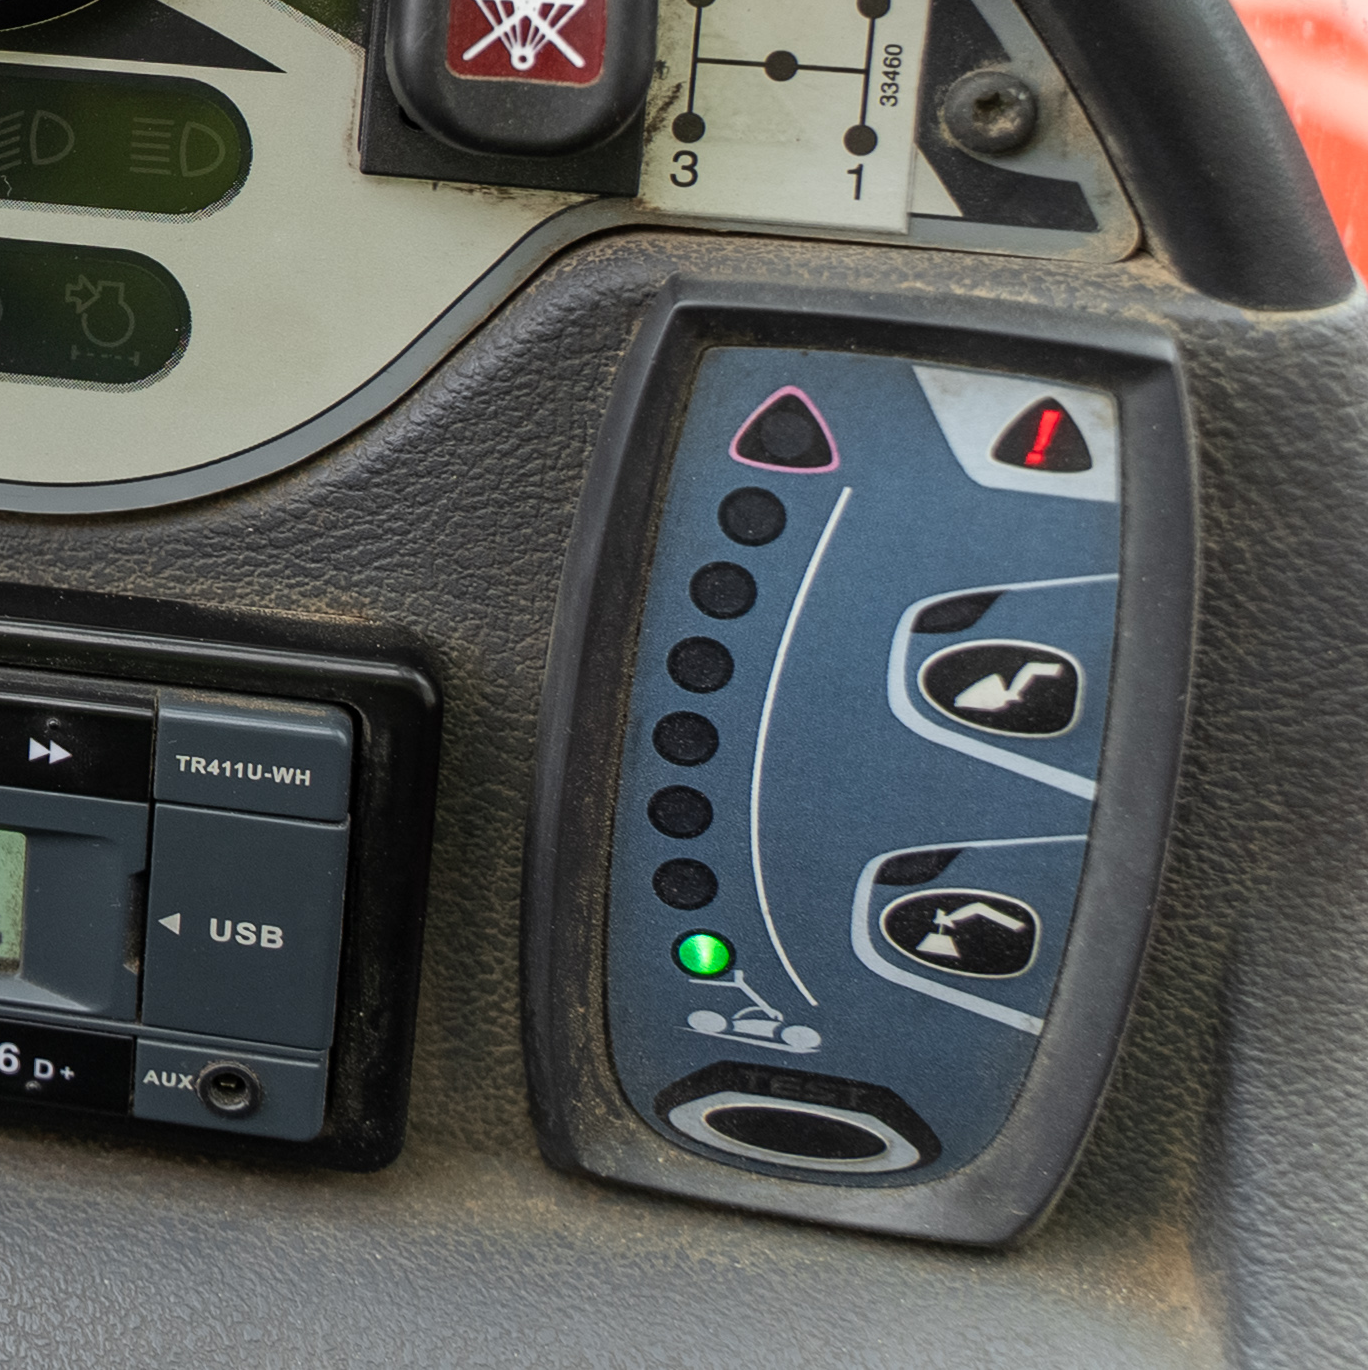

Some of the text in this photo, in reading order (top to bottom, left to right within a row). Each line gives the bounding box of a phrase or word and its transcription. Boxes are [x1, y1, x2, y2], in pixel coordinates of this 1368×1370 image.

[879, 43, 903, 107] 33460
[669, 150, 698, 188] 3
[847, 163, 864, 200] 1
[176, 754, 311, 787] TR411U-WH
[209, 916, 284, 950] USB
[142, 1069, 195, 1091] AUX
